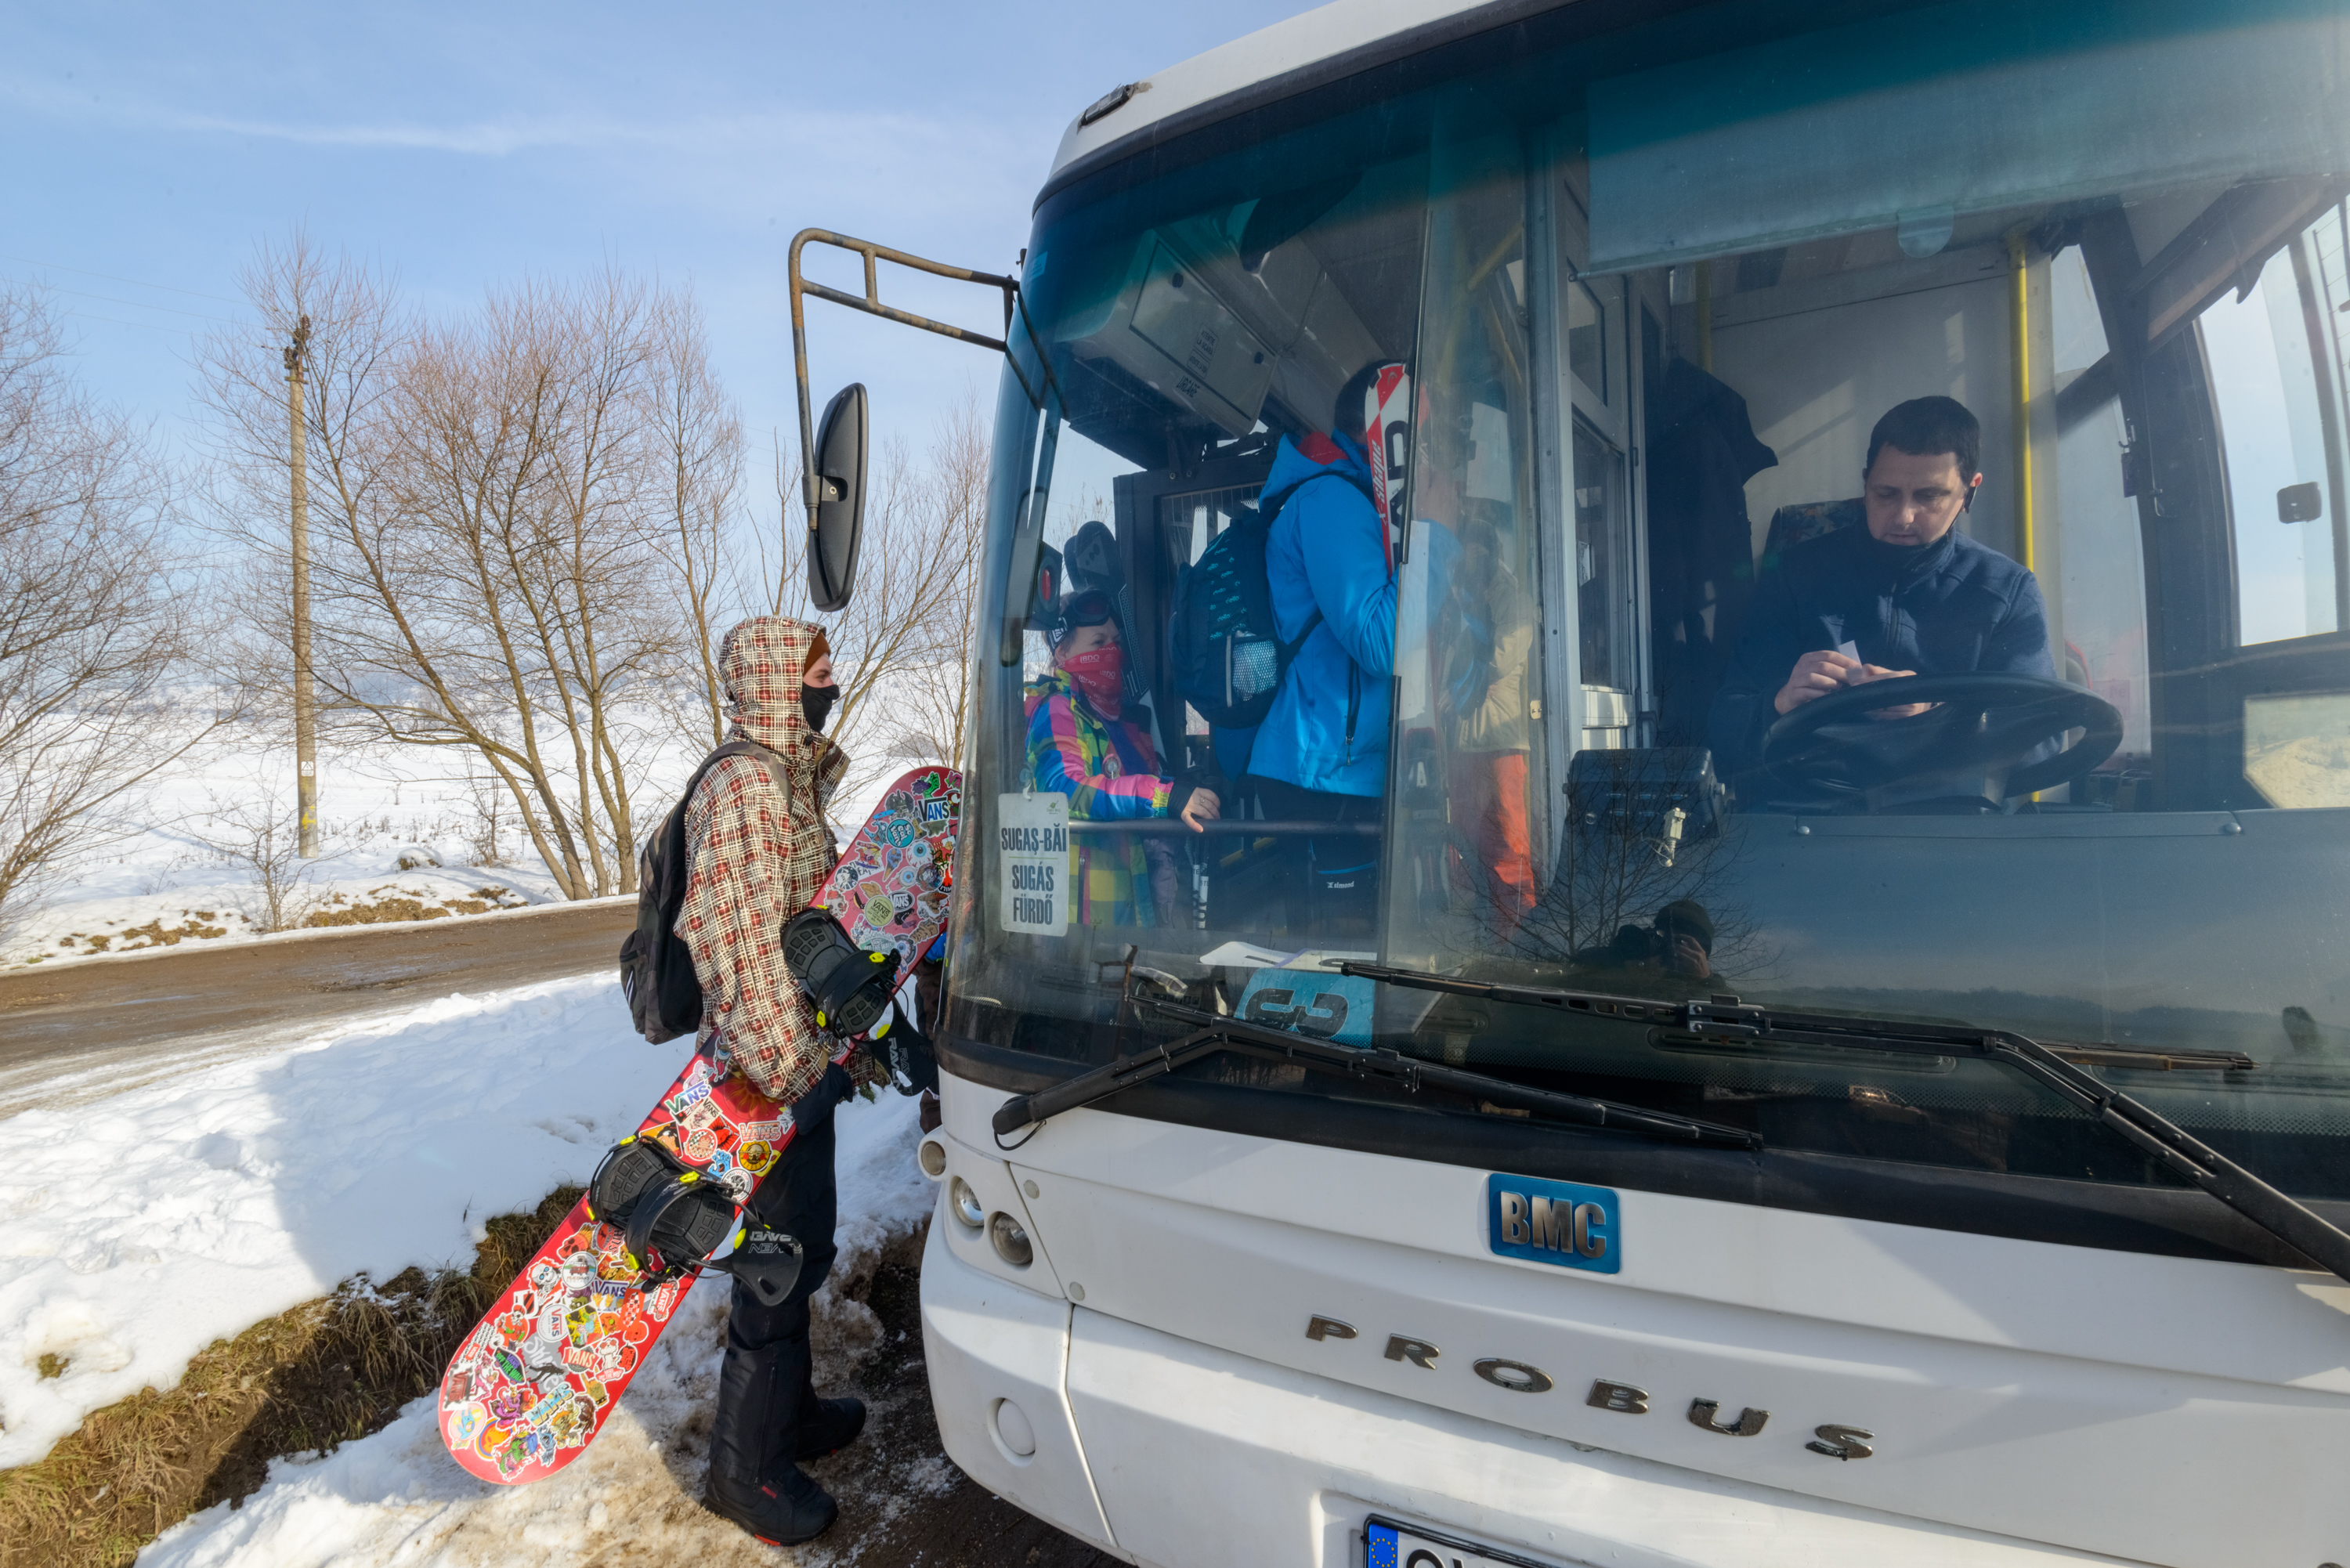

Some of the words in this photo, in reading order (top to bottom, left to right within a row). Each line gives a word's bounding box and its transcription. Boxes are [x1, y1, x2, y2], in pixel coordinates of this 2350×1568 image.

[1176, 376, 1200, 398] URCARE
[1082, 655, 1099, 663] BDO
[918, 797, 949, 822] VANS
[889, 825, 902, 846] Vans
[1012, 862, 1054, 891] SUGÁS
[873, 899, 891, 917] VANS
[888, 894, 909, 908] VANS
[1013, 894, 1054, 925] FÜRDŐ
[665, 1081, 709, 1113] VANS
[703, 1098, 719, 1118] VANS
[739, 1122, 781, 1141] VANS
[1500, 1190, 1607, 1259] BMC
[608, 1230, 624, 1254] ANS
[595, 1281, 627, 1297] VANS
[658, 1288, 672, 1313] VANS
[551, 1308, 562, 1337] VANS
[496, 1352, 504, 1364] OFF
[501, 1359, 512, 1375] THE
[508, 1366, 524, 1382] WALL
[506, 1353, 520, 1369] VANS
[568, 1349, 595, 1368] VANS
[448, 1371, 468, 1402] VANS
[1305, 1313, 1875, 1462] PROBUS
[526, 1382, 574, 1425] VANS
